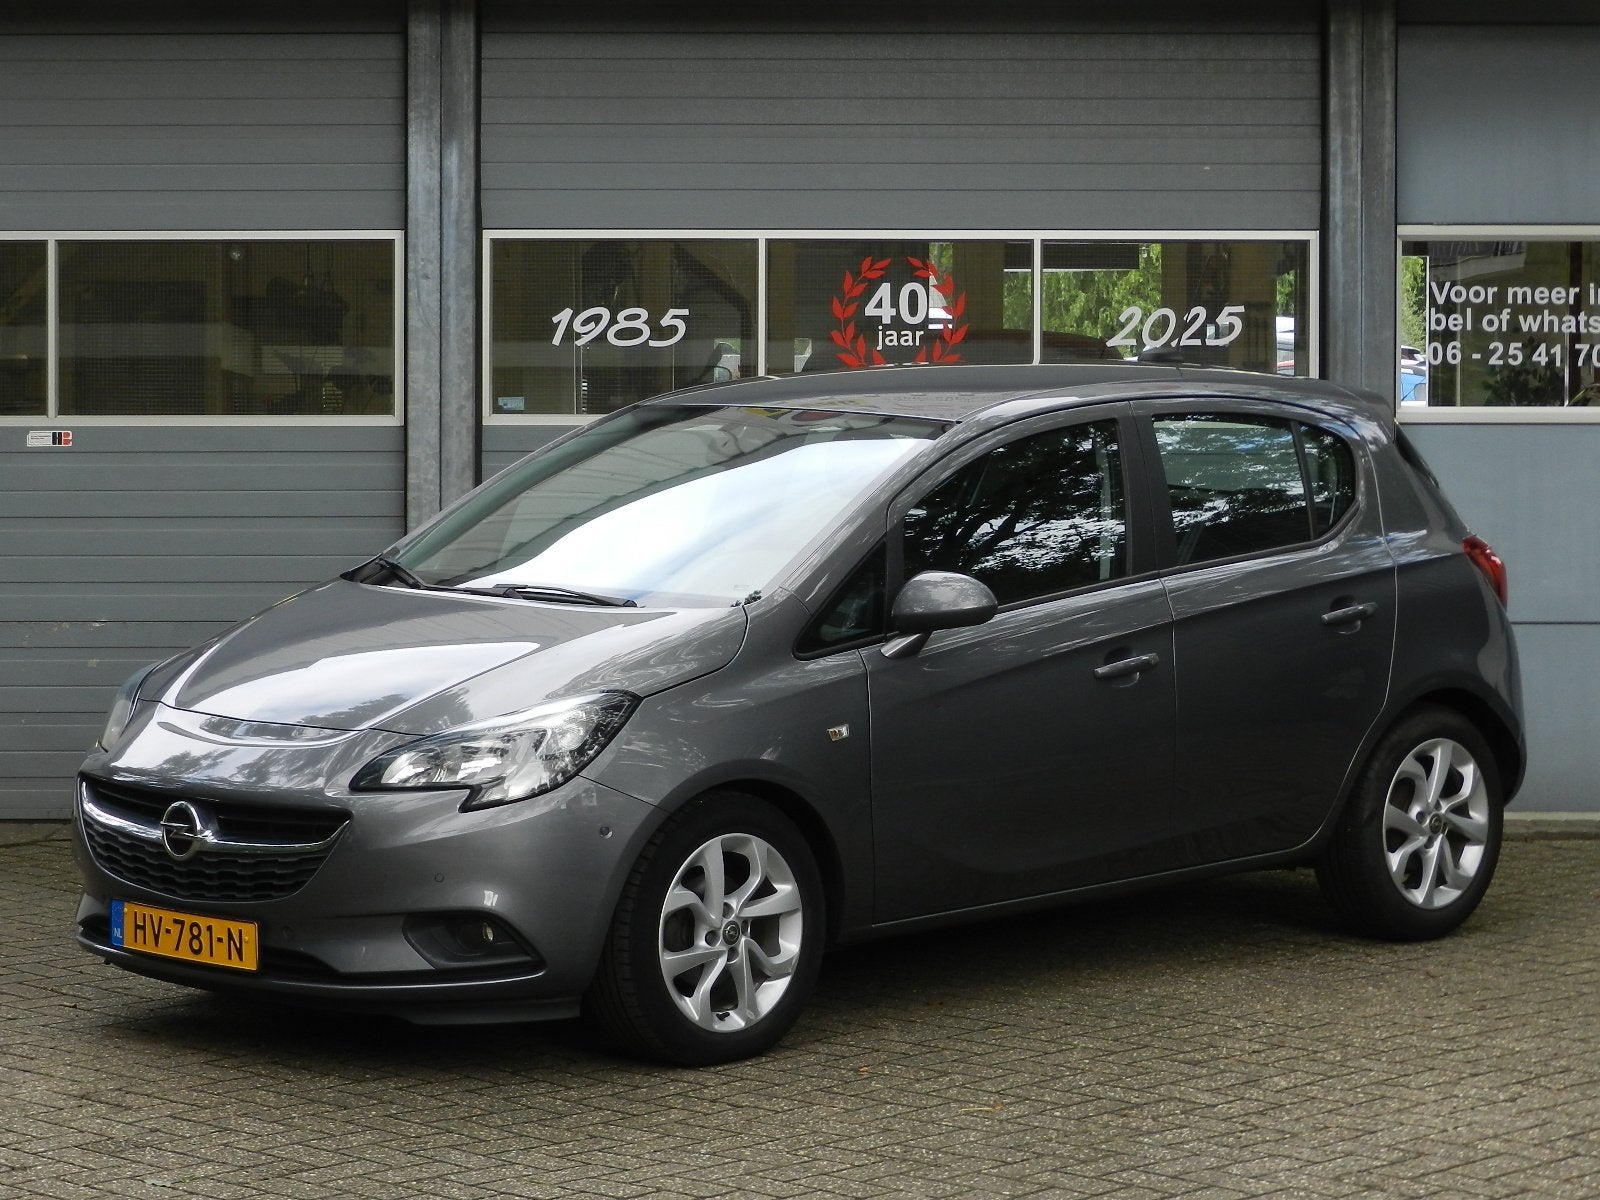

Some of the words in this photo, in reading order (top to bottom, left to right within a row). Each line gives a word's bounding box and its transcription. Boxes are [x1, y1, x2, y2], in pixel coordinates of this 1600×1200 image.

[865, 282, 928, 325] 40
[1430, 281, 1498, 305] Voor
[1507, 285, 1580, 305] meer
[551, 306, 690, 348] 1985
[1105, 305, 1245, 350] 2025
[1430, 307, 1472, 331] bel
[1482, 308, 1511, 332] of
[876, 325, 925, 351] jaar
[1428, 341, 1462, 365] 06
[1488, 342, 1523, 366] 25
[1532, 343, 1561, 367] 41
[113, 927, 123, 939] NL
[134, 910, 244, 962] HV-781-N
